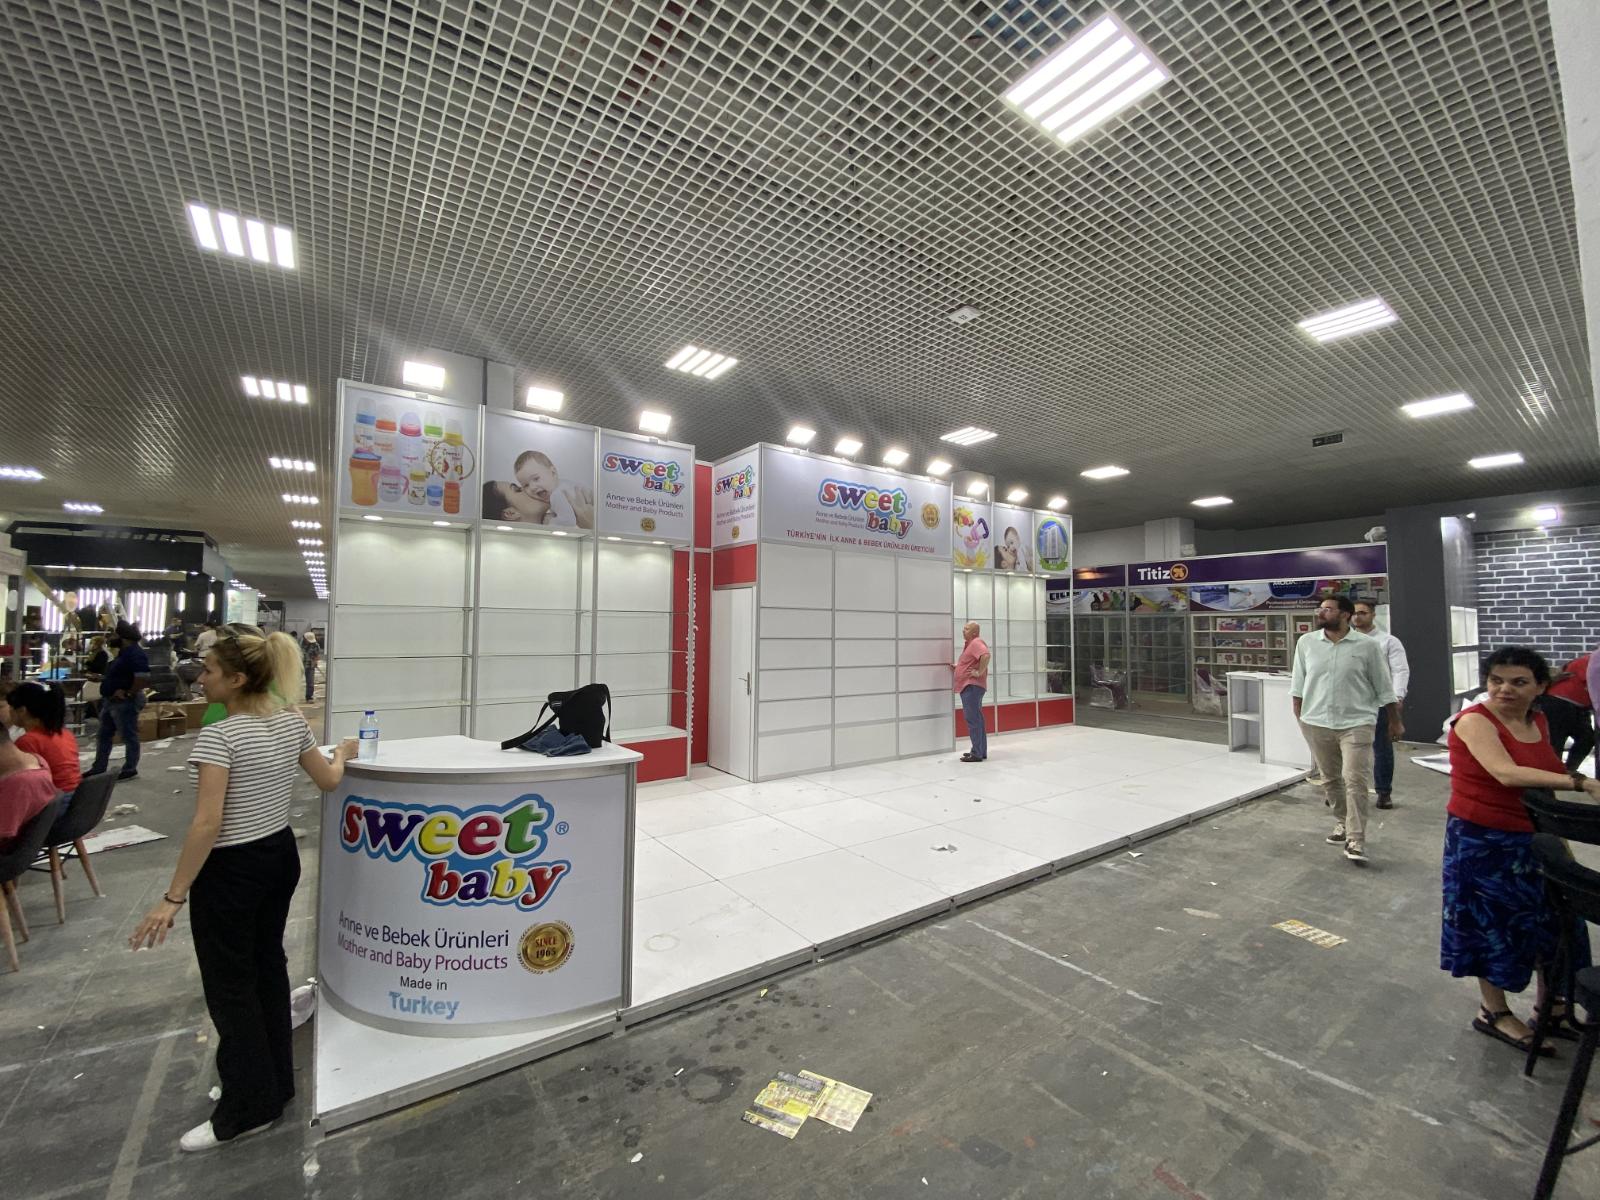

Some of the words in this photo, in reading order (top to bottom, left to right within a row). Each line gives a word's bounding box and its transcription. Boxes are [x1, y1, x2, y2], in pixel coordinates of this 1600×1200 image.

[606, 455, 678, 479] sweet
[644, 477, 682, 495] baby
[716, 468, 752, 494] sweet
[821, 482, 906, 514] sweet
[866, 511, 913, 538] baby
[1137, 567, 1171, 581] Titiz
[343, 803, 545, 856] sweet
[426, 858, 566, 906] baby
[338, 909, 363, 936] Anne
[364, 924, 380, 941] ve
[382, 925, 431, 948] Bebek
[434, 928, 509, 949] Ürünleri
[337, 930, 369, 960] Mother
[369, 948, 393, 966] and
[395, 951, 432, 974] Baby
[435, 954, 508, 971] Products
[399, 975, 432, 990] Made
[436, 979, 448, 991] in
[388, 991, 460, 1019] Turkey
